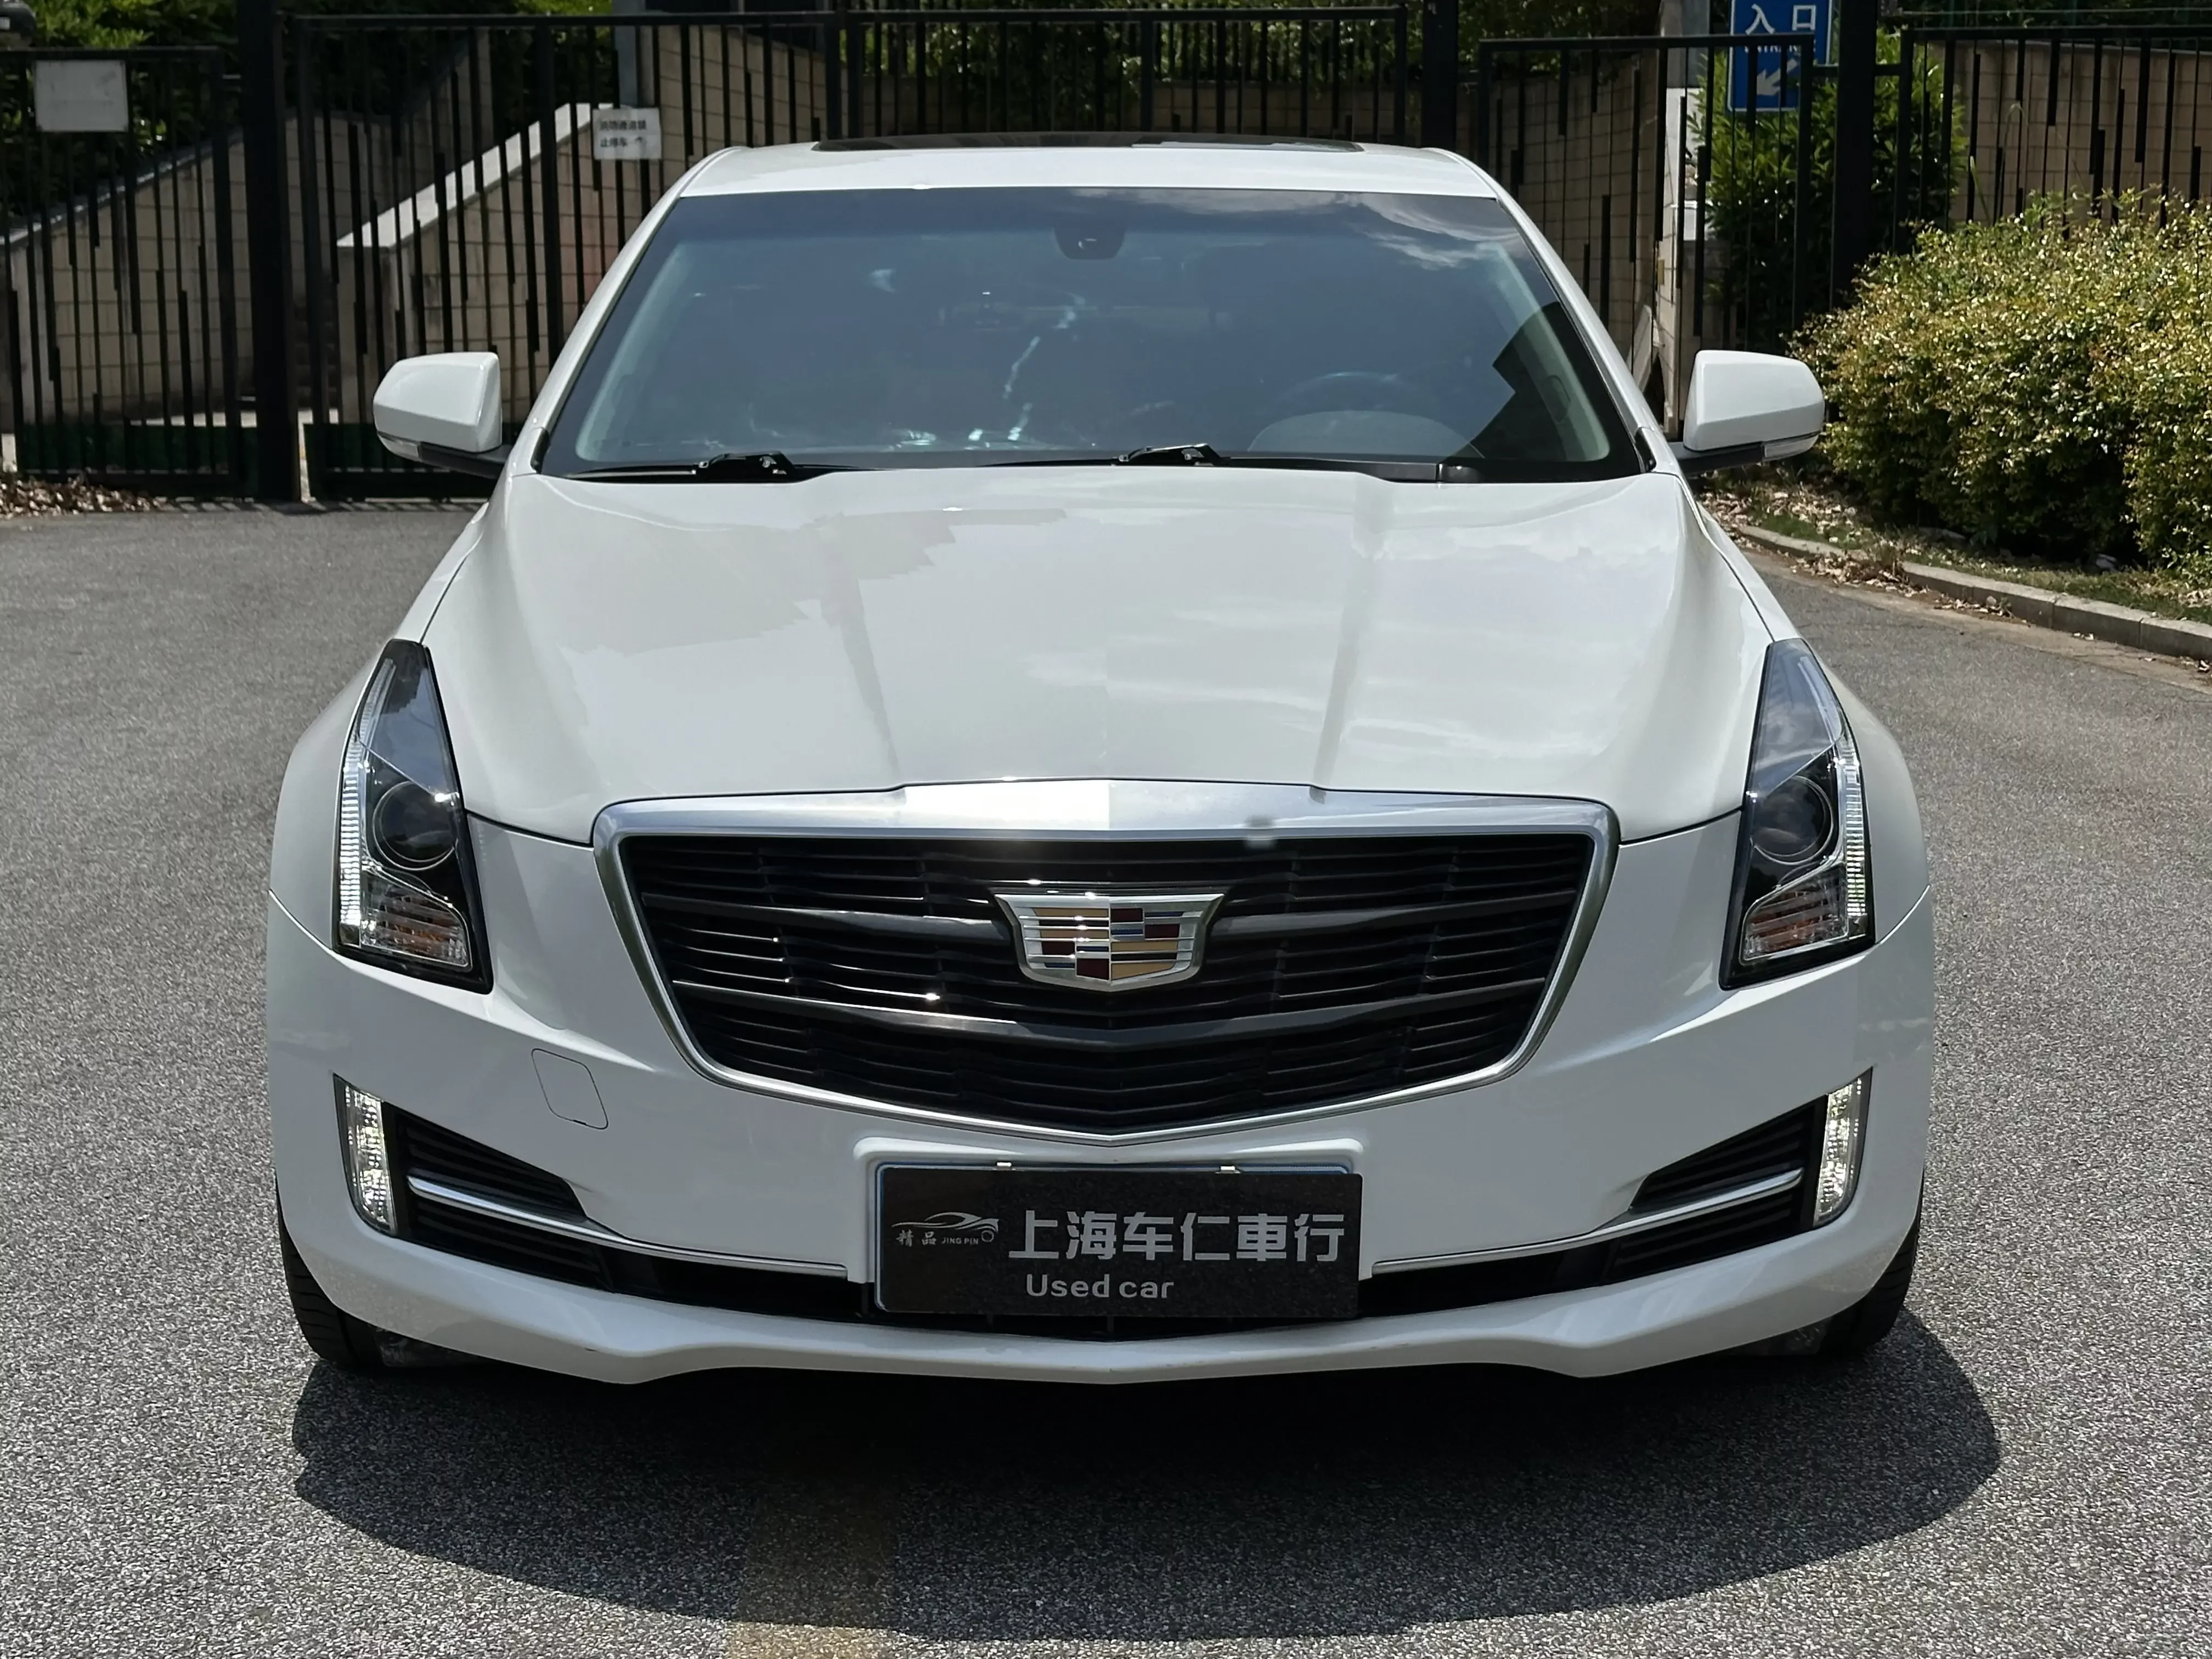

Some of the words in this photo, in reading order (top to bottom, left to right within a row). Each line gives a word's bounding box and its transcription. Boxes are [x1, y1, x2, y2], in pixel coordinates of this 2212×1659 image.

[1745, 3, 1816, 35] 入口
[896, 1229, 937, 1247] 精品
[941, 1237, 962, 1245] JING
[1009, 1210, 1345, 1262] 上海车仁車行
[1027, 1274, 1109, 1298] Used
[1120, 1282, 1175, 1299] car
